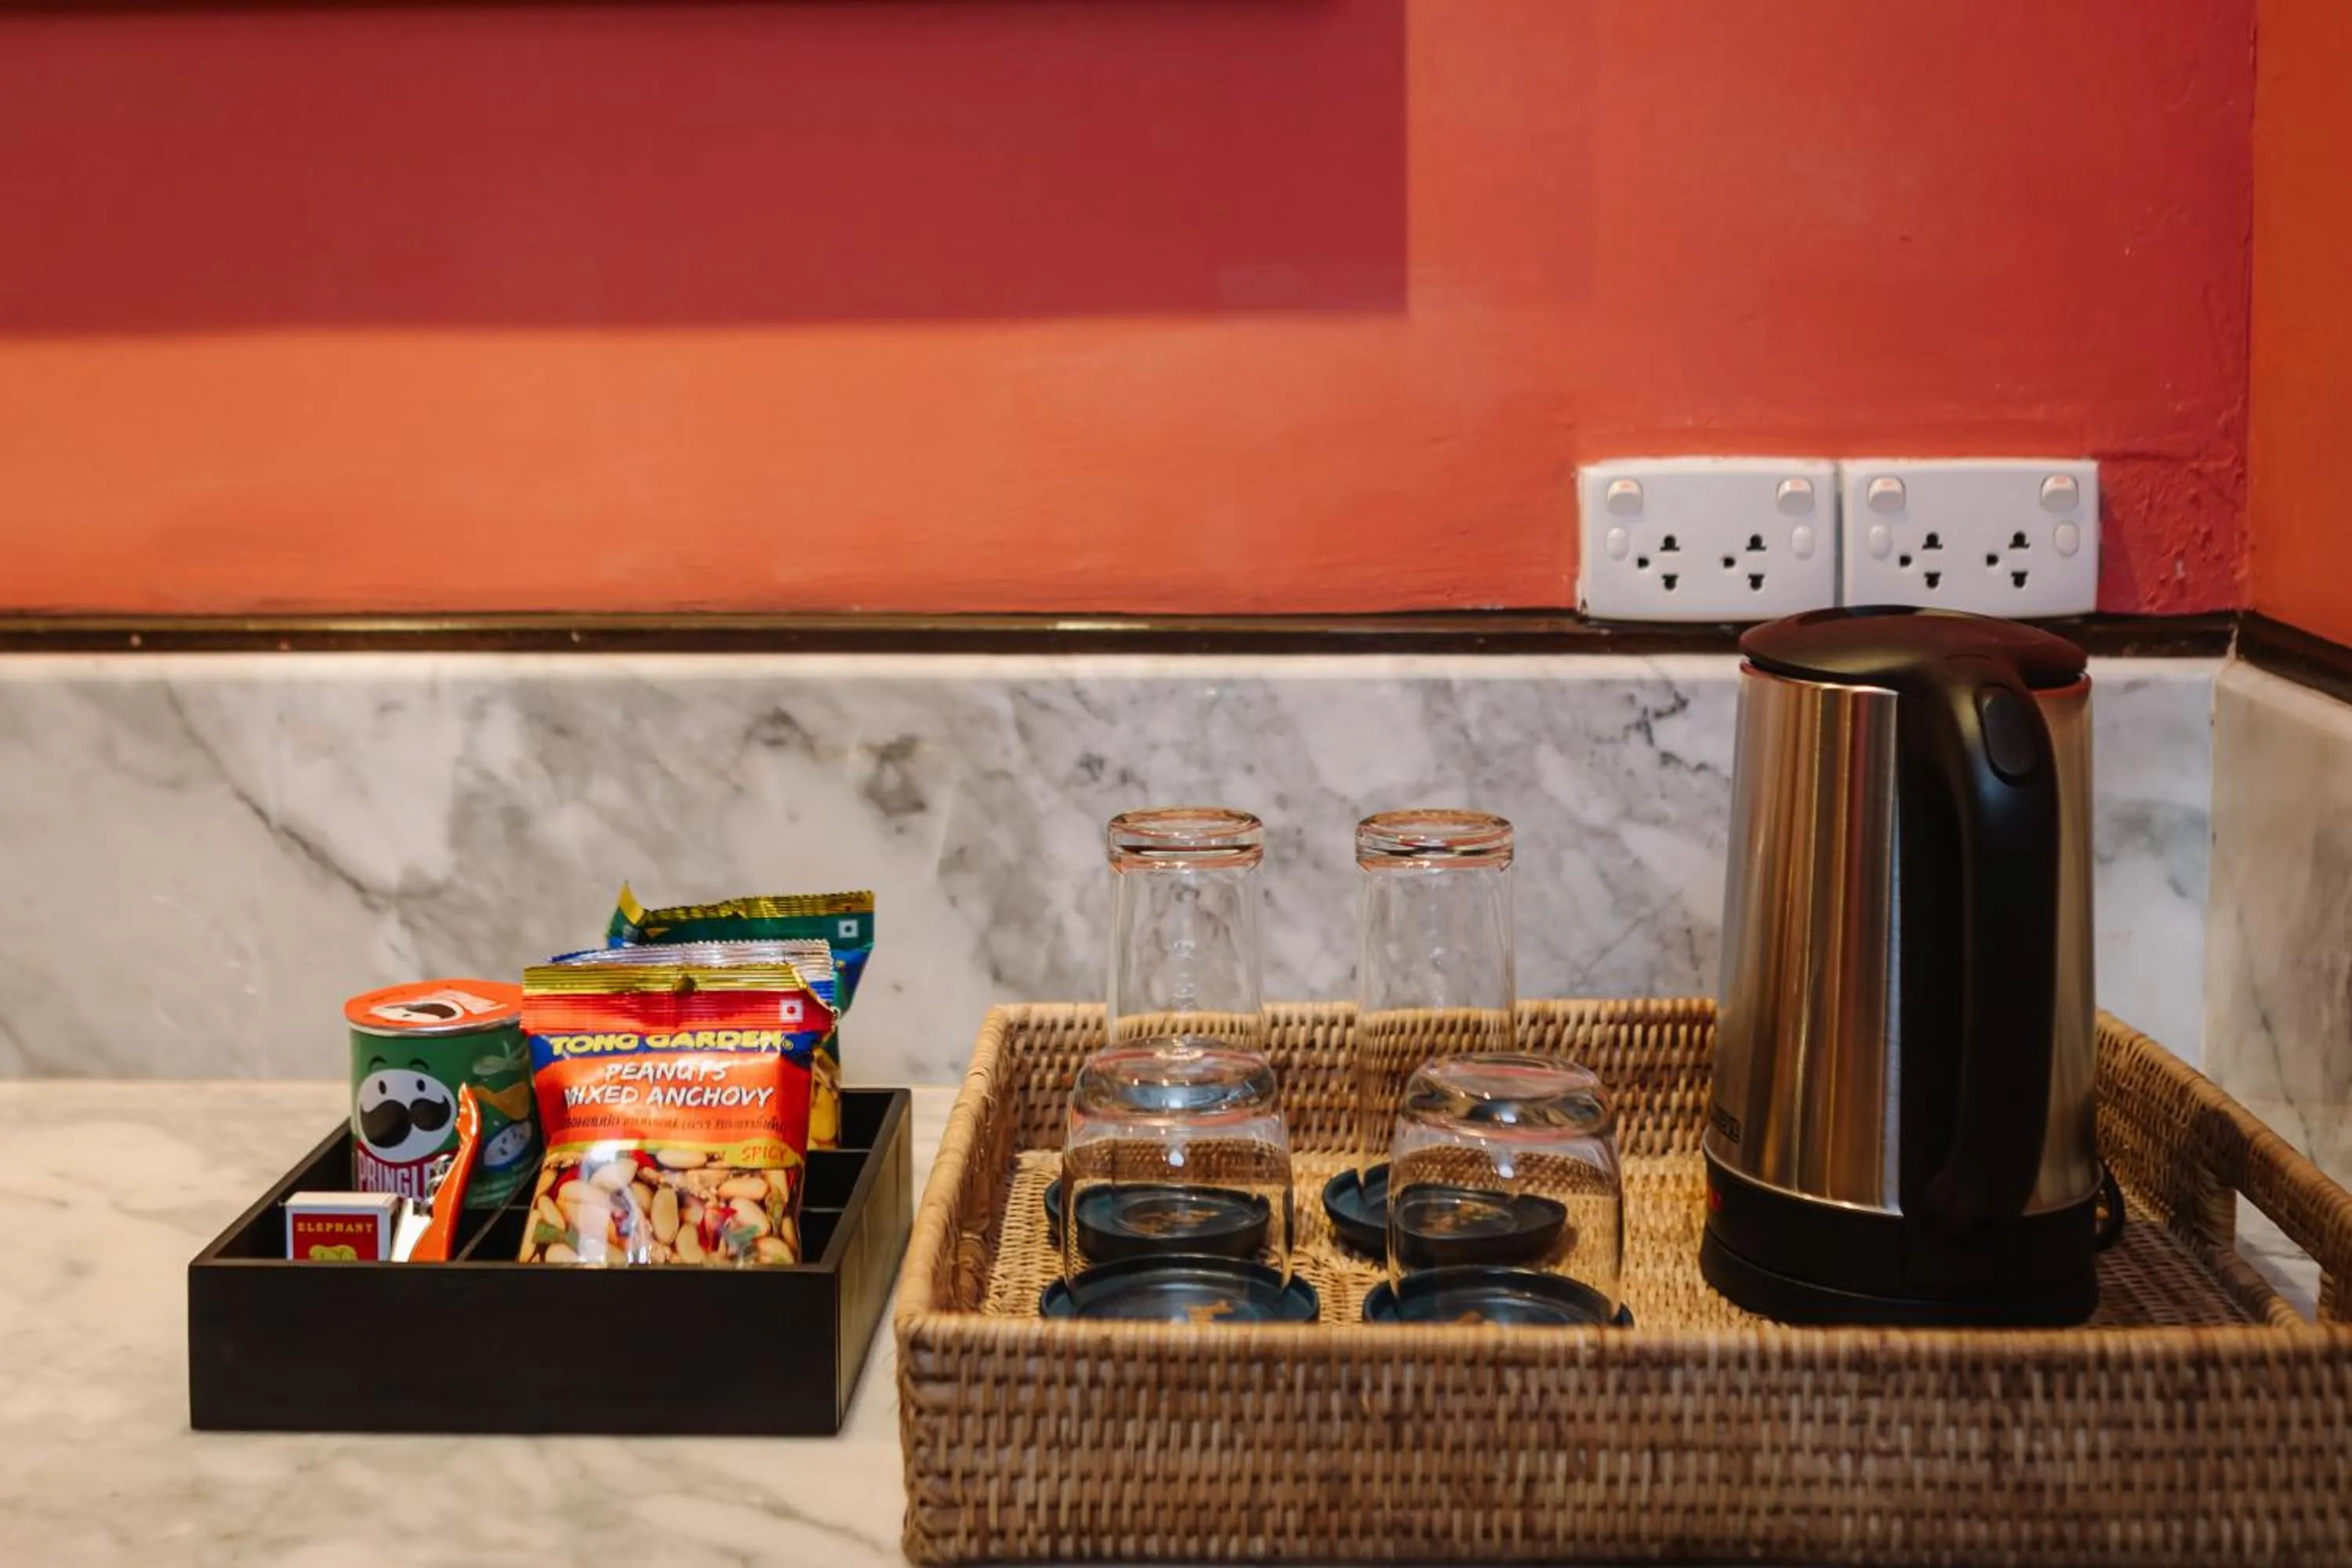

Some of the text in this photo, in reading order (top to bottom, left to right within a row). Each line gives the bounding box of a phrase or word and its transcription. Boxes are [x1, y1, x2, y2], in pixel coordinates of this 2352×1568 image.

[549, 1030, 782, 1055] TONG GARDEN
[604, 1058, 729, 1083] PEANUTS
[645, 1085, 775, 1108] ANCHOVY
[740, 1145, 789, 1162] SPICY
[358, 1149, 445, 1204] PRINGLE
[296, 1221, 374, 1233] ELEPHANT
